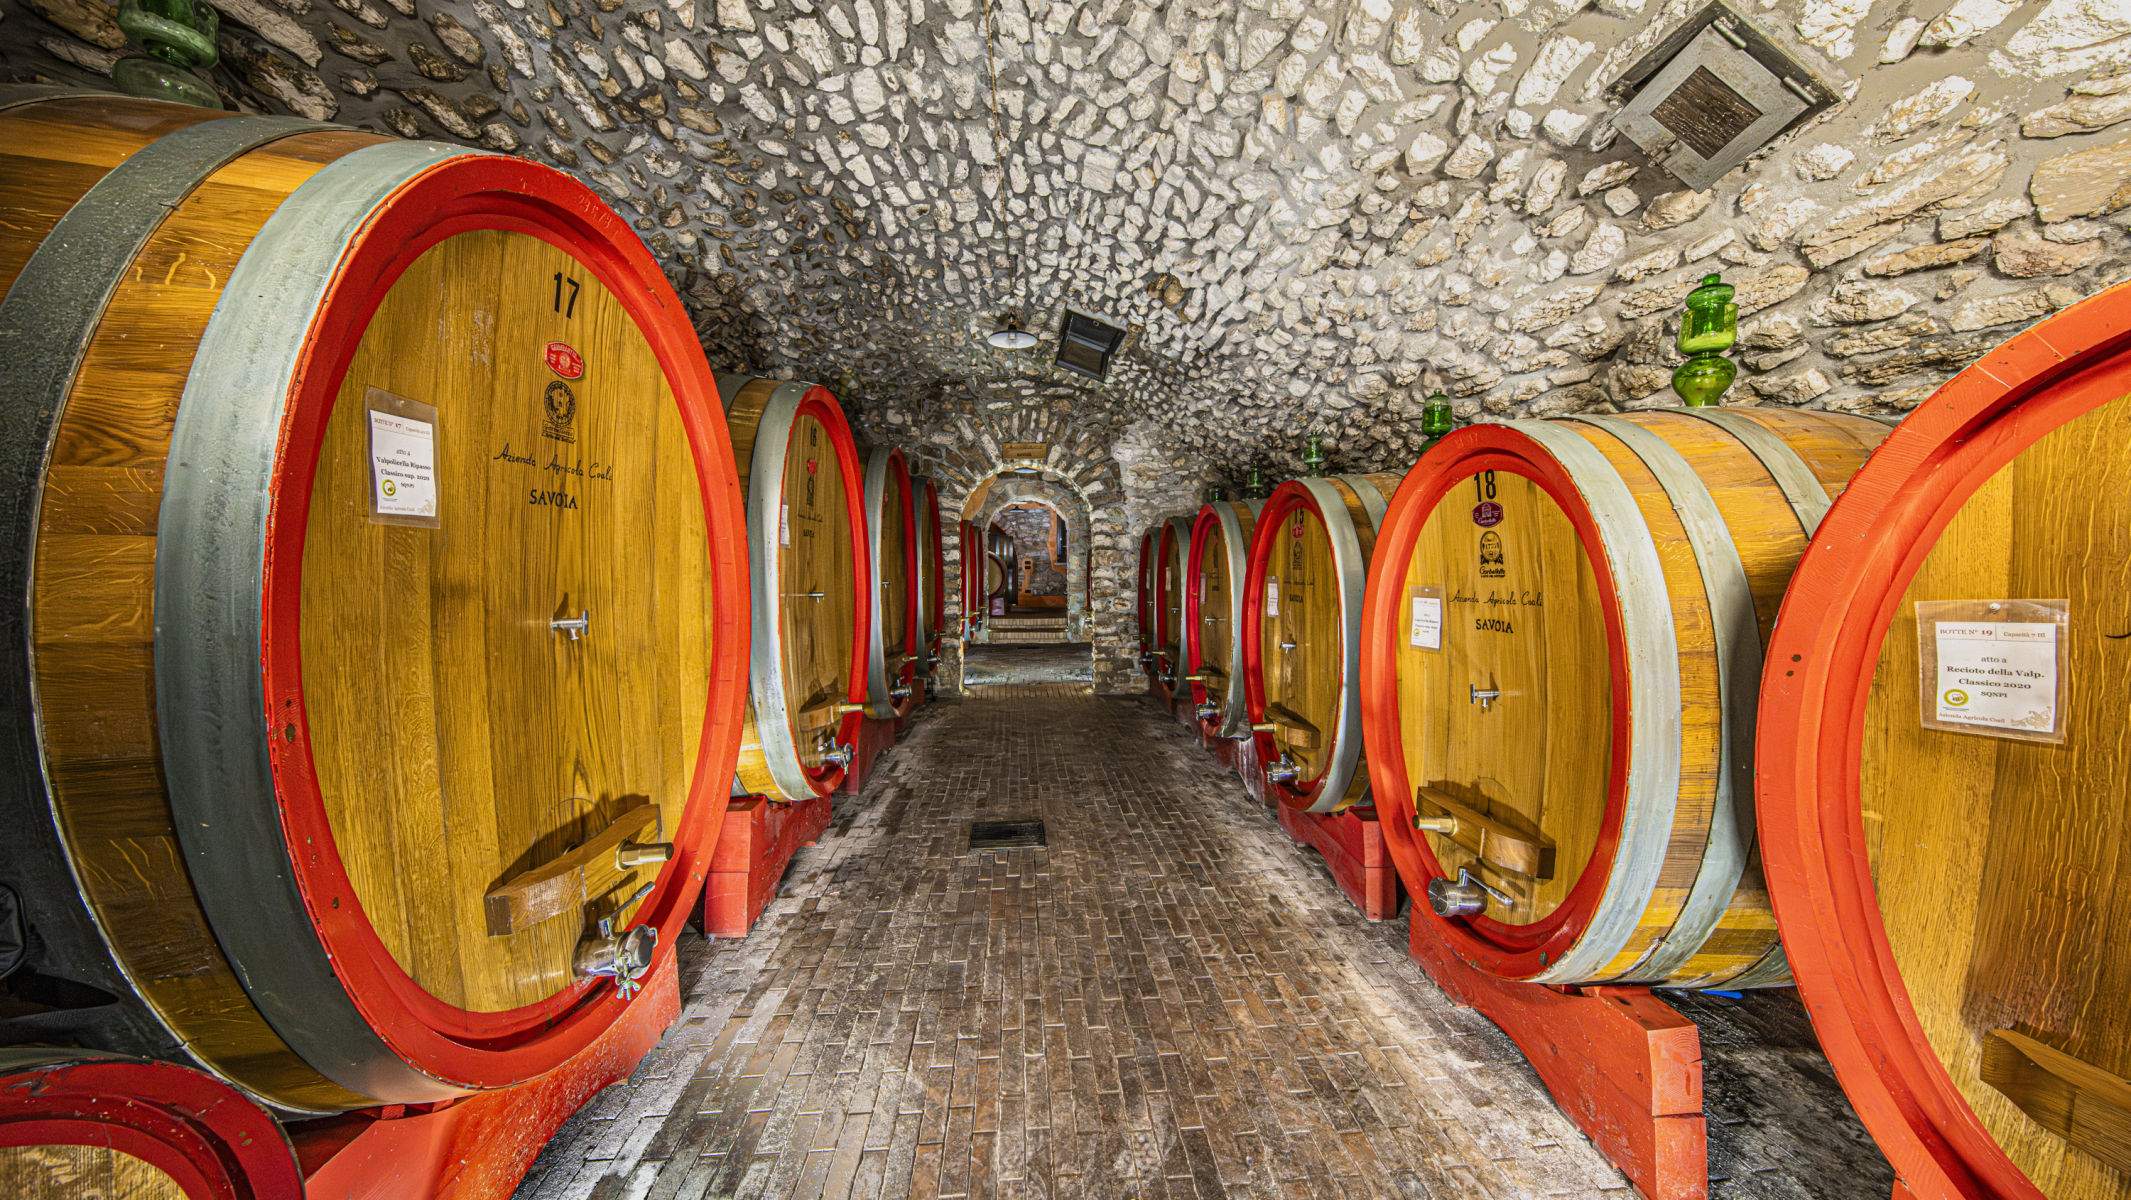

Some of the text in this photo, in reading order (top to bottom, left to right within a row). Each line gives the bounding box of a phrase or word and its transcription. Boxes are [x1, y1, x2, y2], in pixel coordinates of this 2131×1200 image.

[554, 271, 580, 319] 17
[376, 456, 409, 467] Valpolicella
[493, 442, 536, 466] Azienda
[544, 453, 584, 476] Agricola
[380, 468, 404, 477] Classico
[1474, 469, 1497, 502] 18
[529, 489, 578, 510] SAVOIA
[1482, 590, 1517, 608] Agricola
[1475, 619, 1514, 634] SAVOIA
[1946, 665, 2045, 679] Recioto della Valp.
[1958, 678, 2001, 687] Classico
